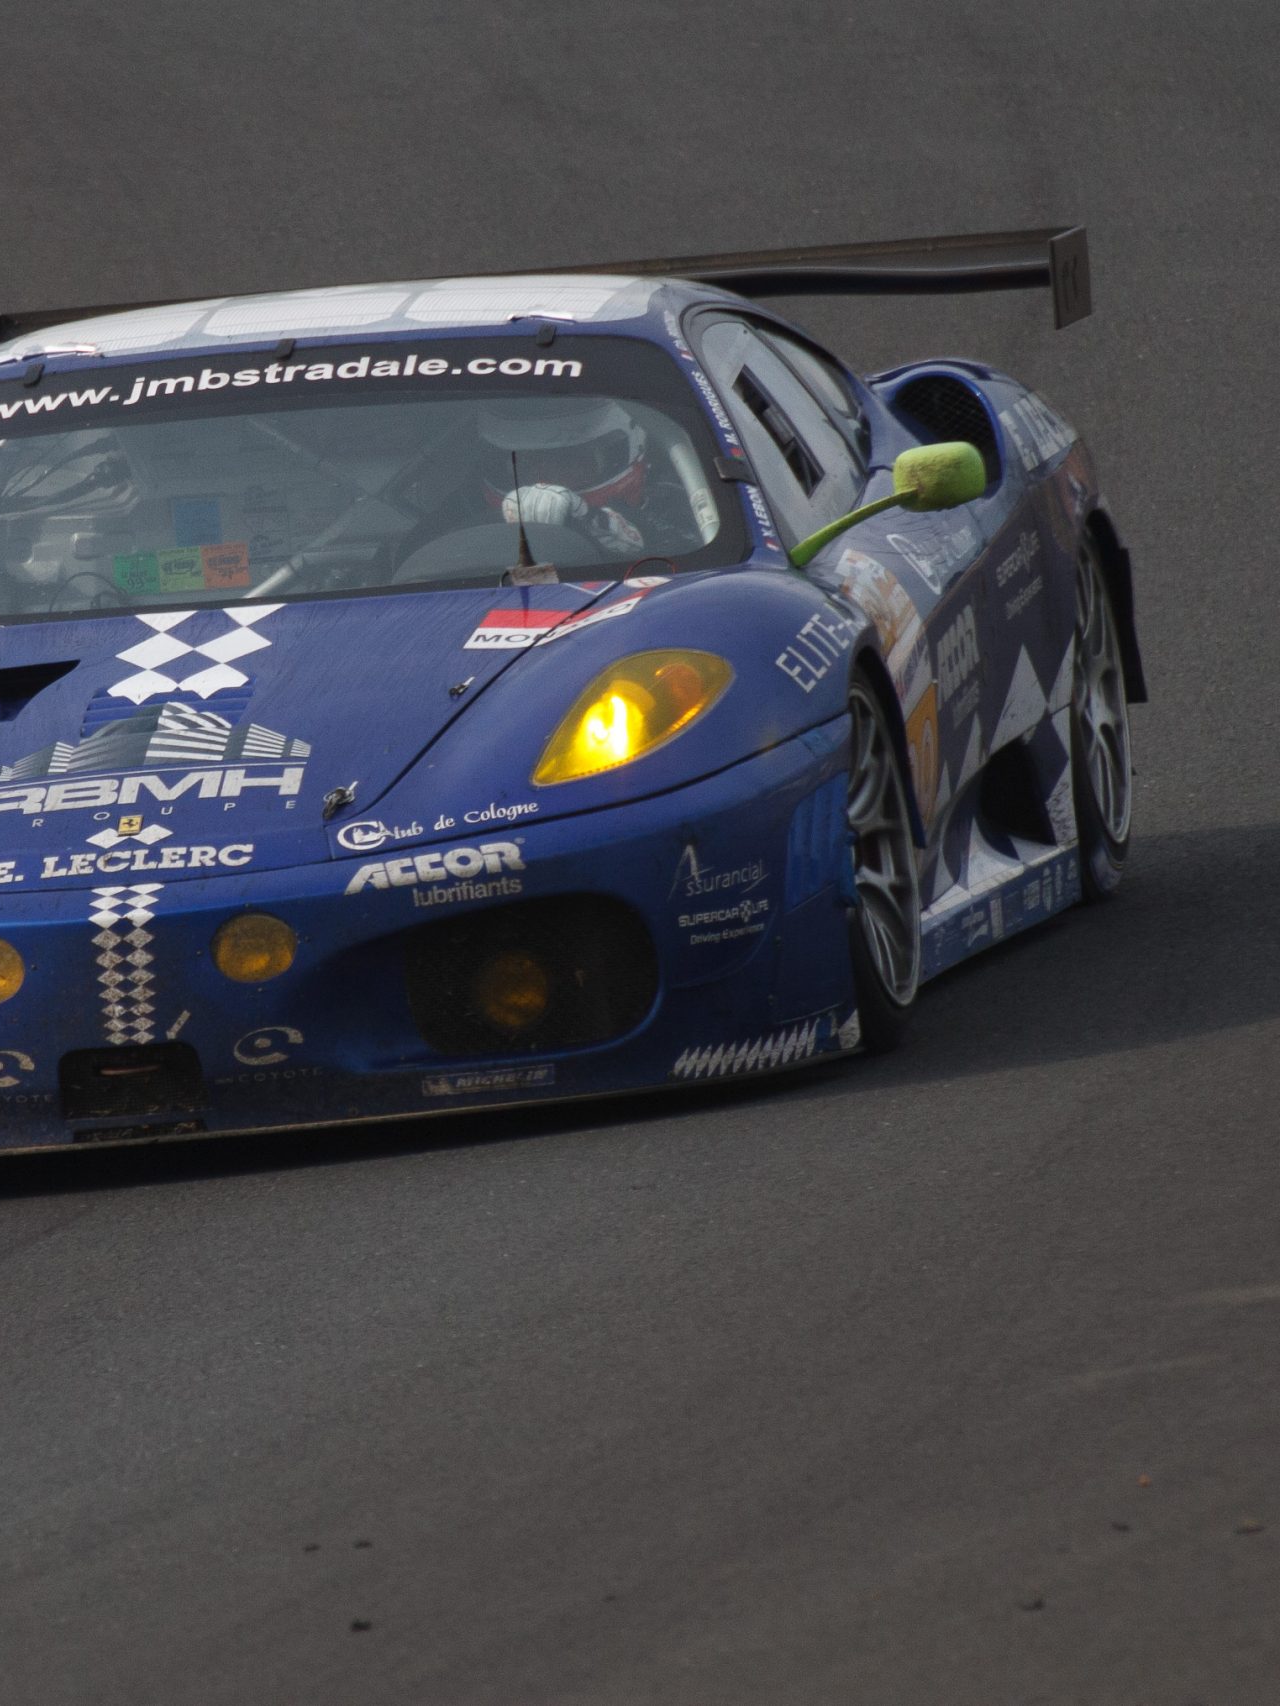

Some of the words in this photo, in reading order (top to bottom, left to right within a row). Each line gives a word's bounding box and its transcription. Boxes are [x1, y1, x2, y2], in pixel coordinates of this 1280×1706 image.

[434, 815, 455, 831] de
[463, 802, 539, 828] Cologne
[41, 844, 254, 879] LECLERC
[344, 842, 526, 896] ACCOR
[413, 876, 522, 908] lubrifiants
[678, 907, 740, 928] SUPERCAR
